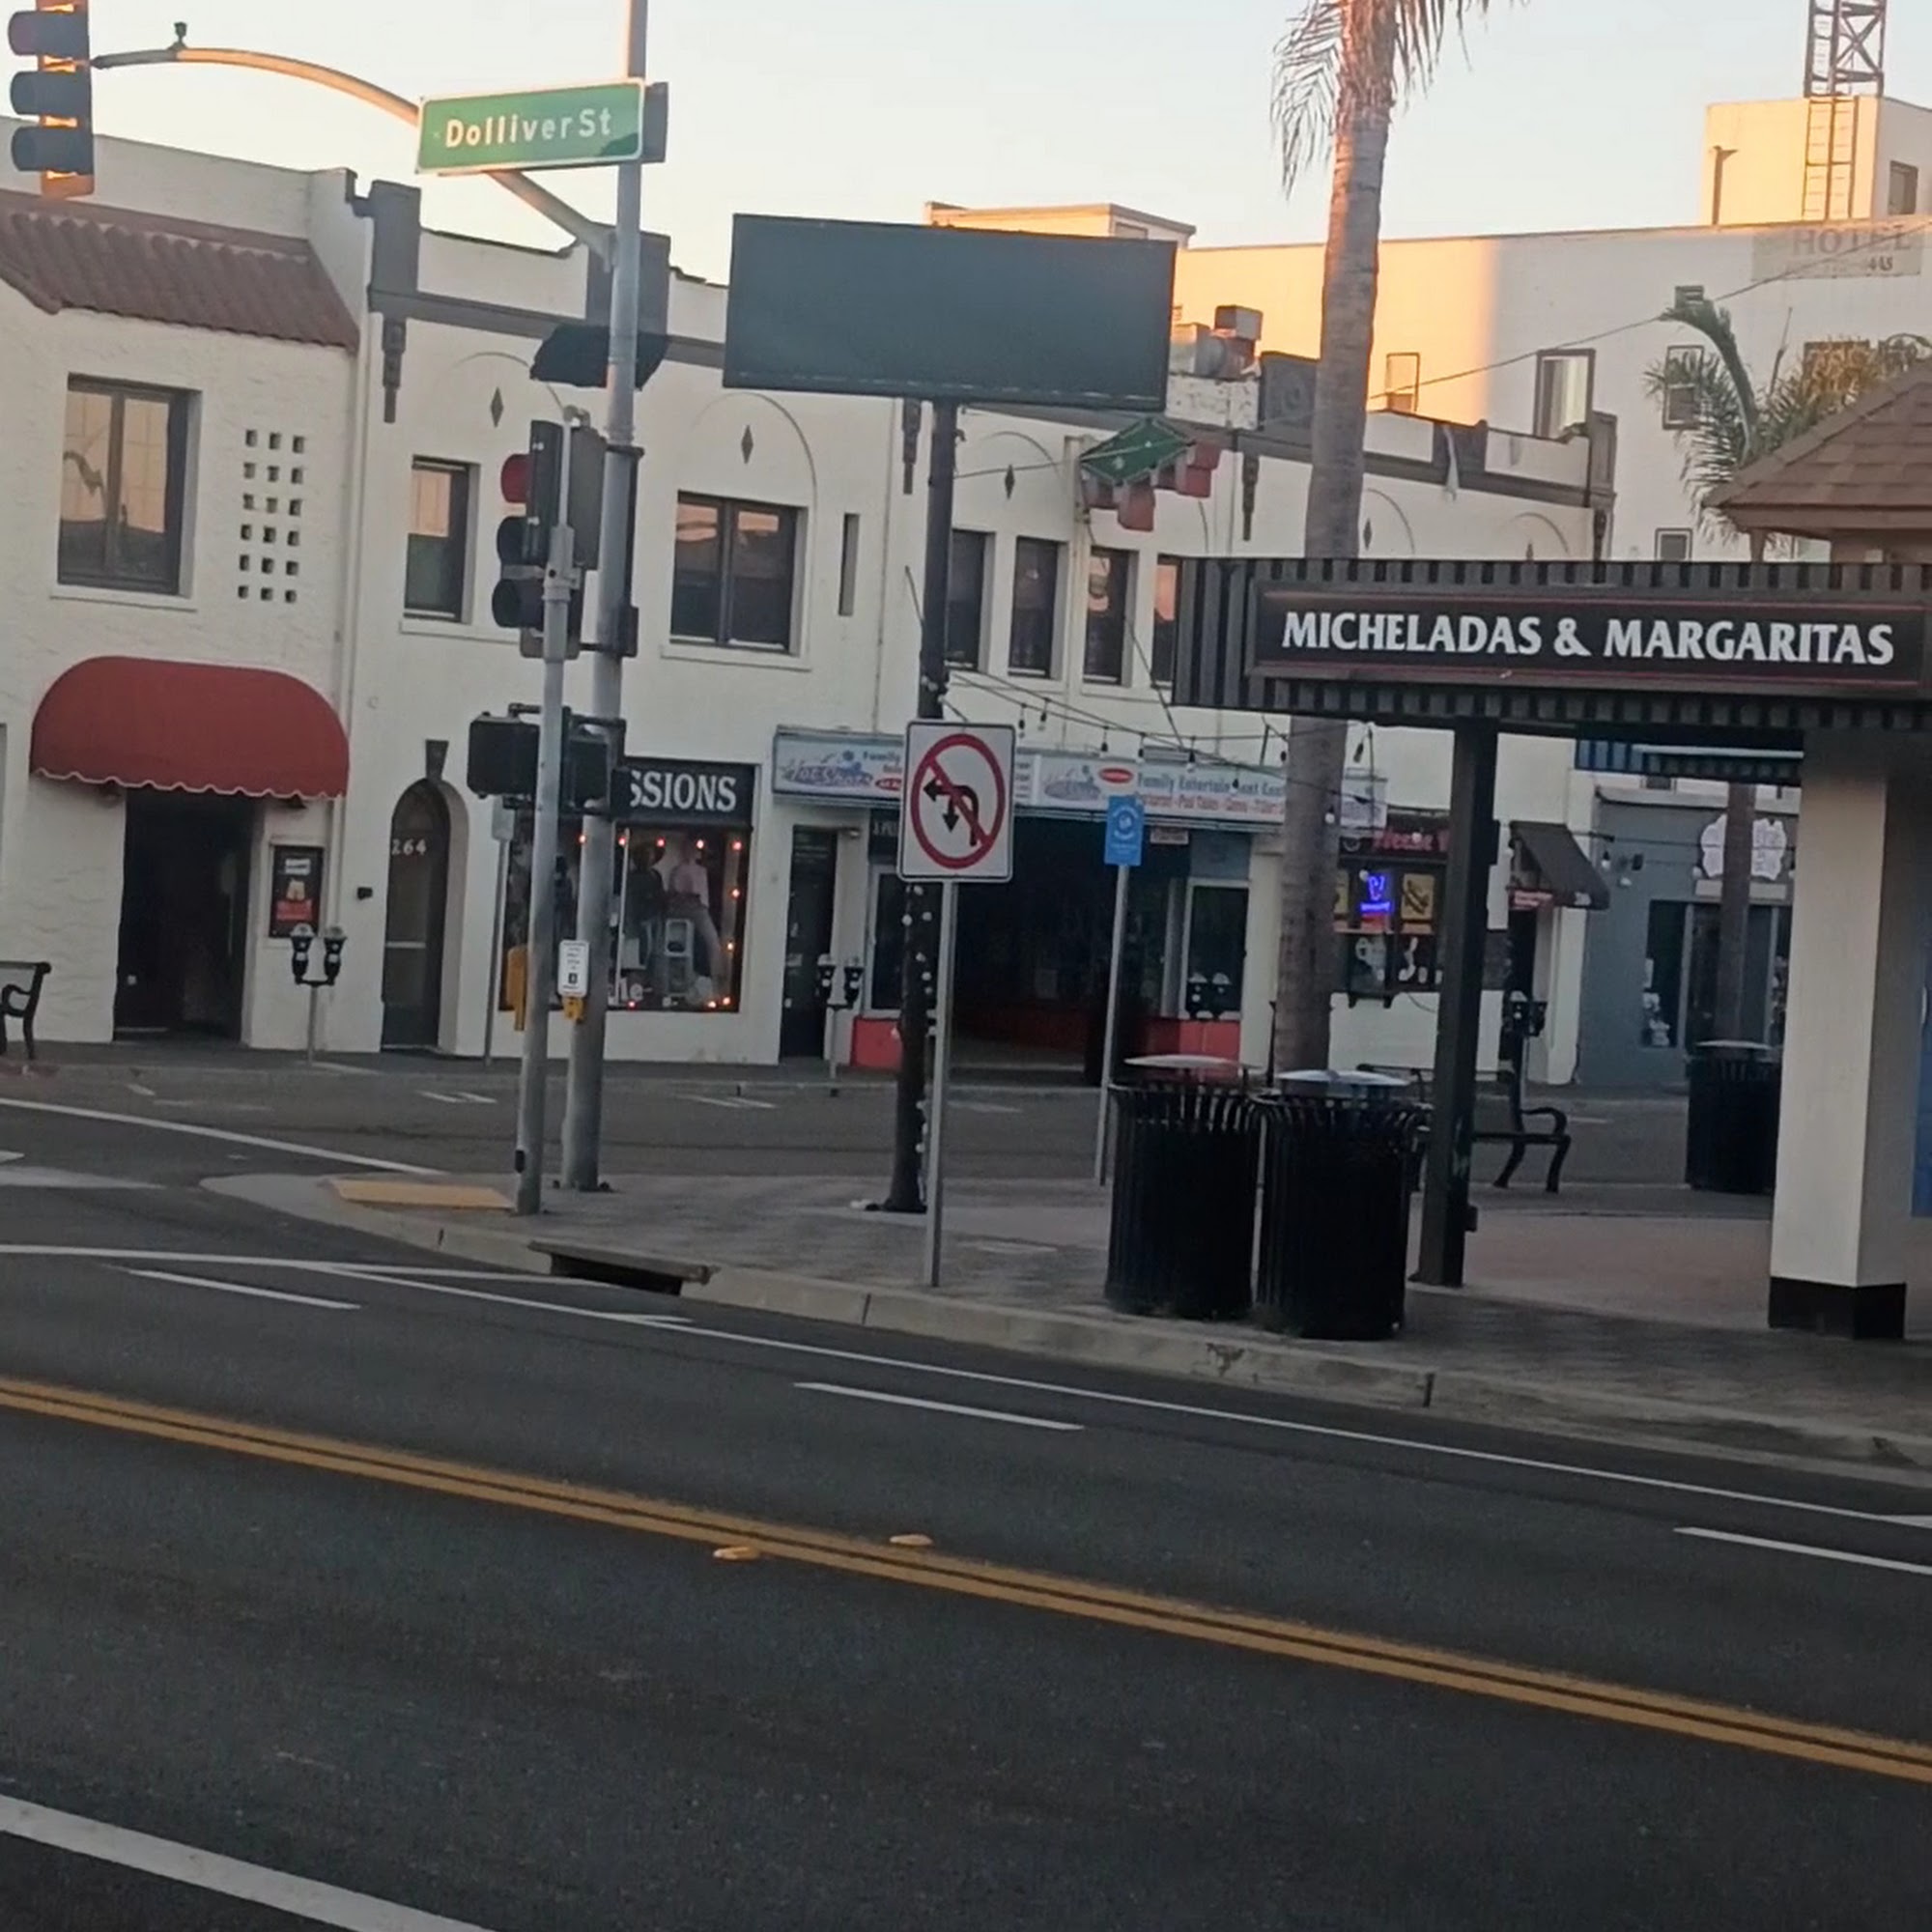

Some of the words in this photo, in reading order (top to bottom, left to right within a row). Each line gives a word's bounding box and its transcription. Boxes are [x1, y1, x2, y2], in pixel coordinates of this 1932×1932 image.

[445, 114, 573, 147] Dolliver
[579, 107, 611, 137] St
[1792, 224, 1913, 255] HOTEL
[1282, 611, 1543, 655] MICHELADAS
[1553, 617, 1593, 657] &
[1603, 618, 1894, 666] MARGARITAS
[391, 838, 427, 856] 264
